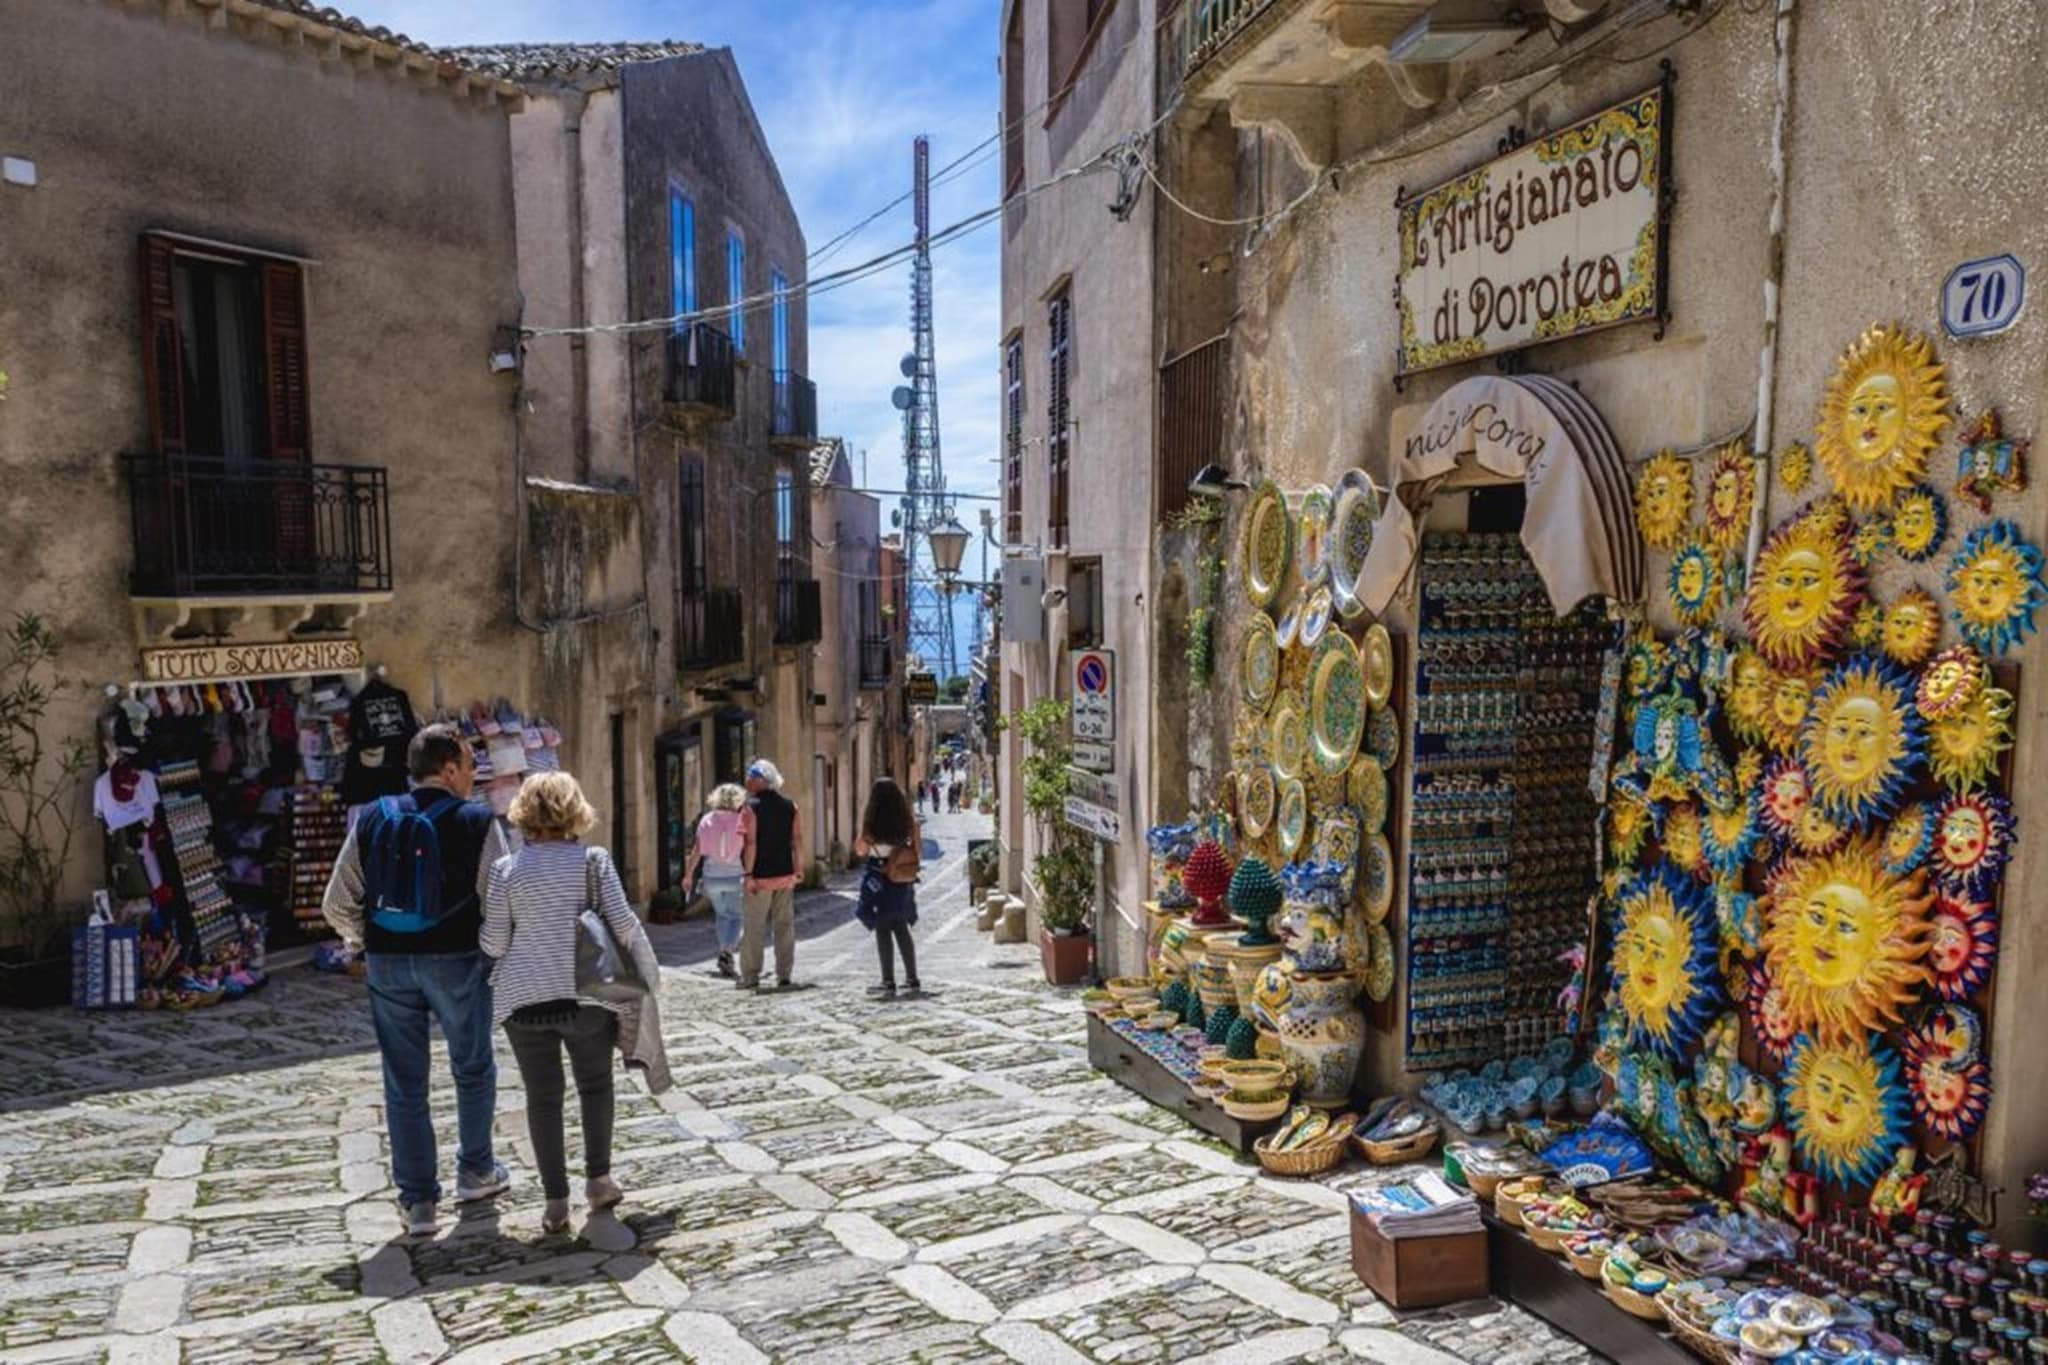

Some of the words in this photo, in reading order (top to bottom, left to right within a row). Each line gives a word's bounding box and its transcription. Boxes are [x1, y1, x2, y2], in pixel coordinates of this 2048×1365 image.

[1411, 135, 1642, 269] L'Artigianato
[1434, 287, 1460, 344] di
[1468, 254, 1623, 338] Dorotea
[1960, 271, 2006, 323] 70
